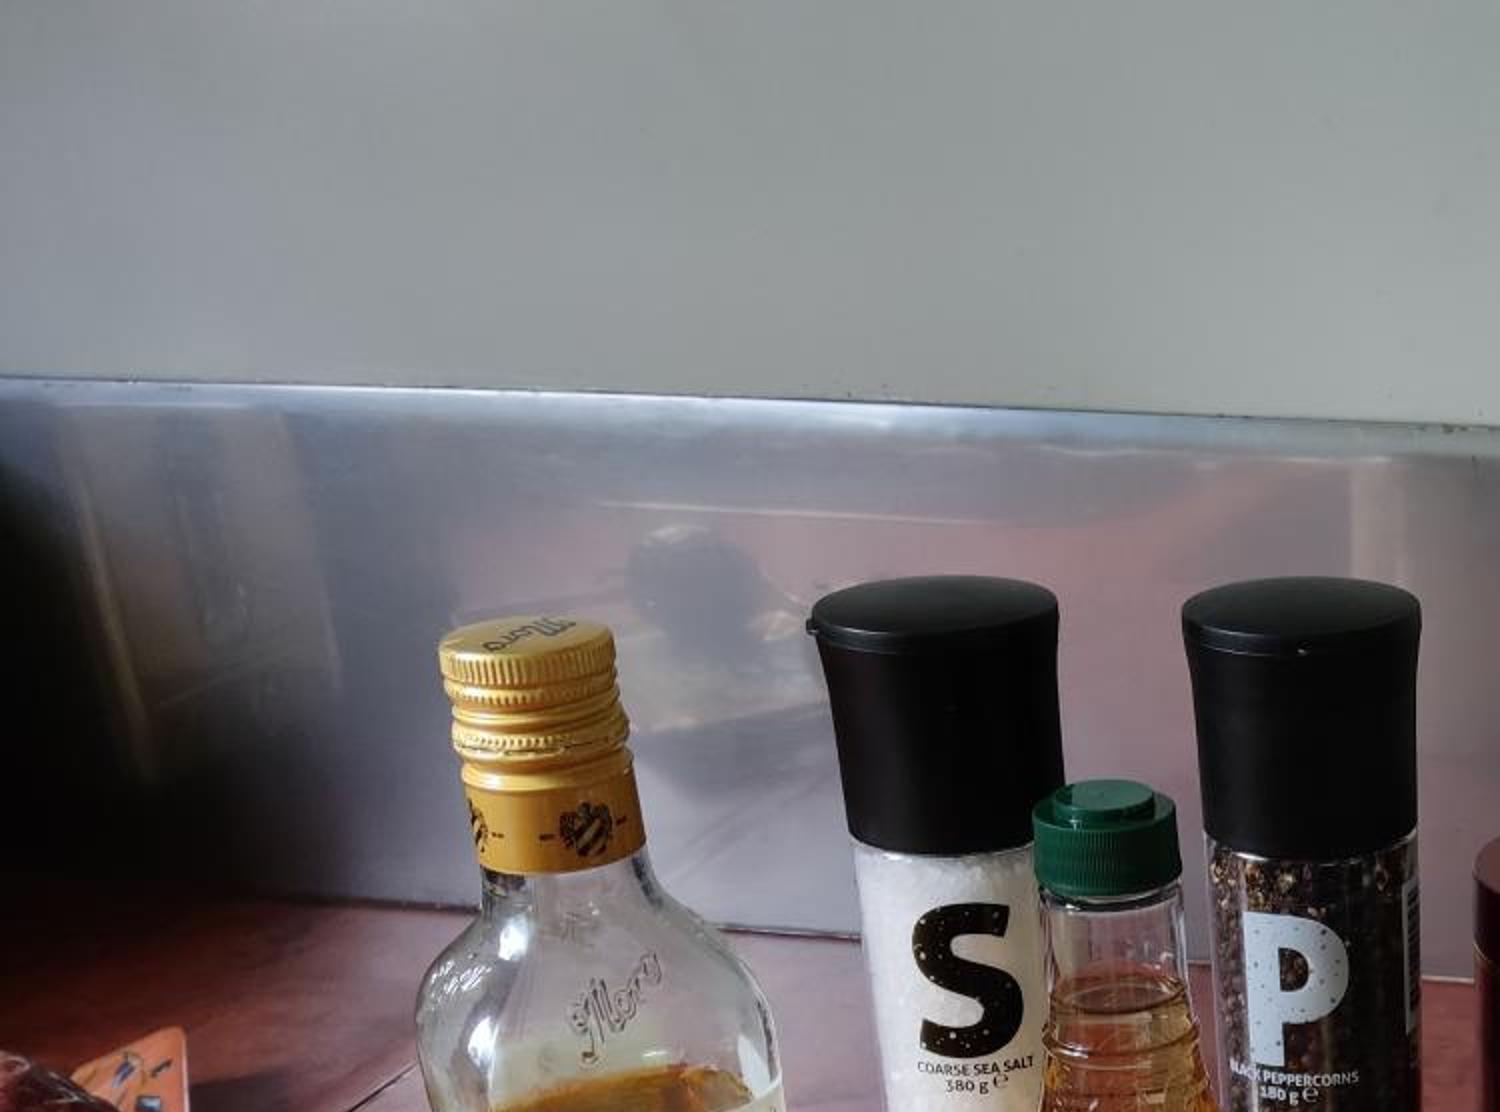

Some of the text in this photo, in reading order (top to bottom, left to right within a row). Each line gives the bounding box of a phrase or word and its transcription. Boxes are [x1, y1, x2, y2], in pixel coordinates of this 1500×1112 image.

[911, 902, 1024, 1058] S
[1242, 911, 1349, 1067] P
[917, 1055, 1034, 1076] COARSE SEA SALT
[945, 1079, 975, 1093] 380
[1263, 1070, 1360, 1087] PEPPERCORNS
